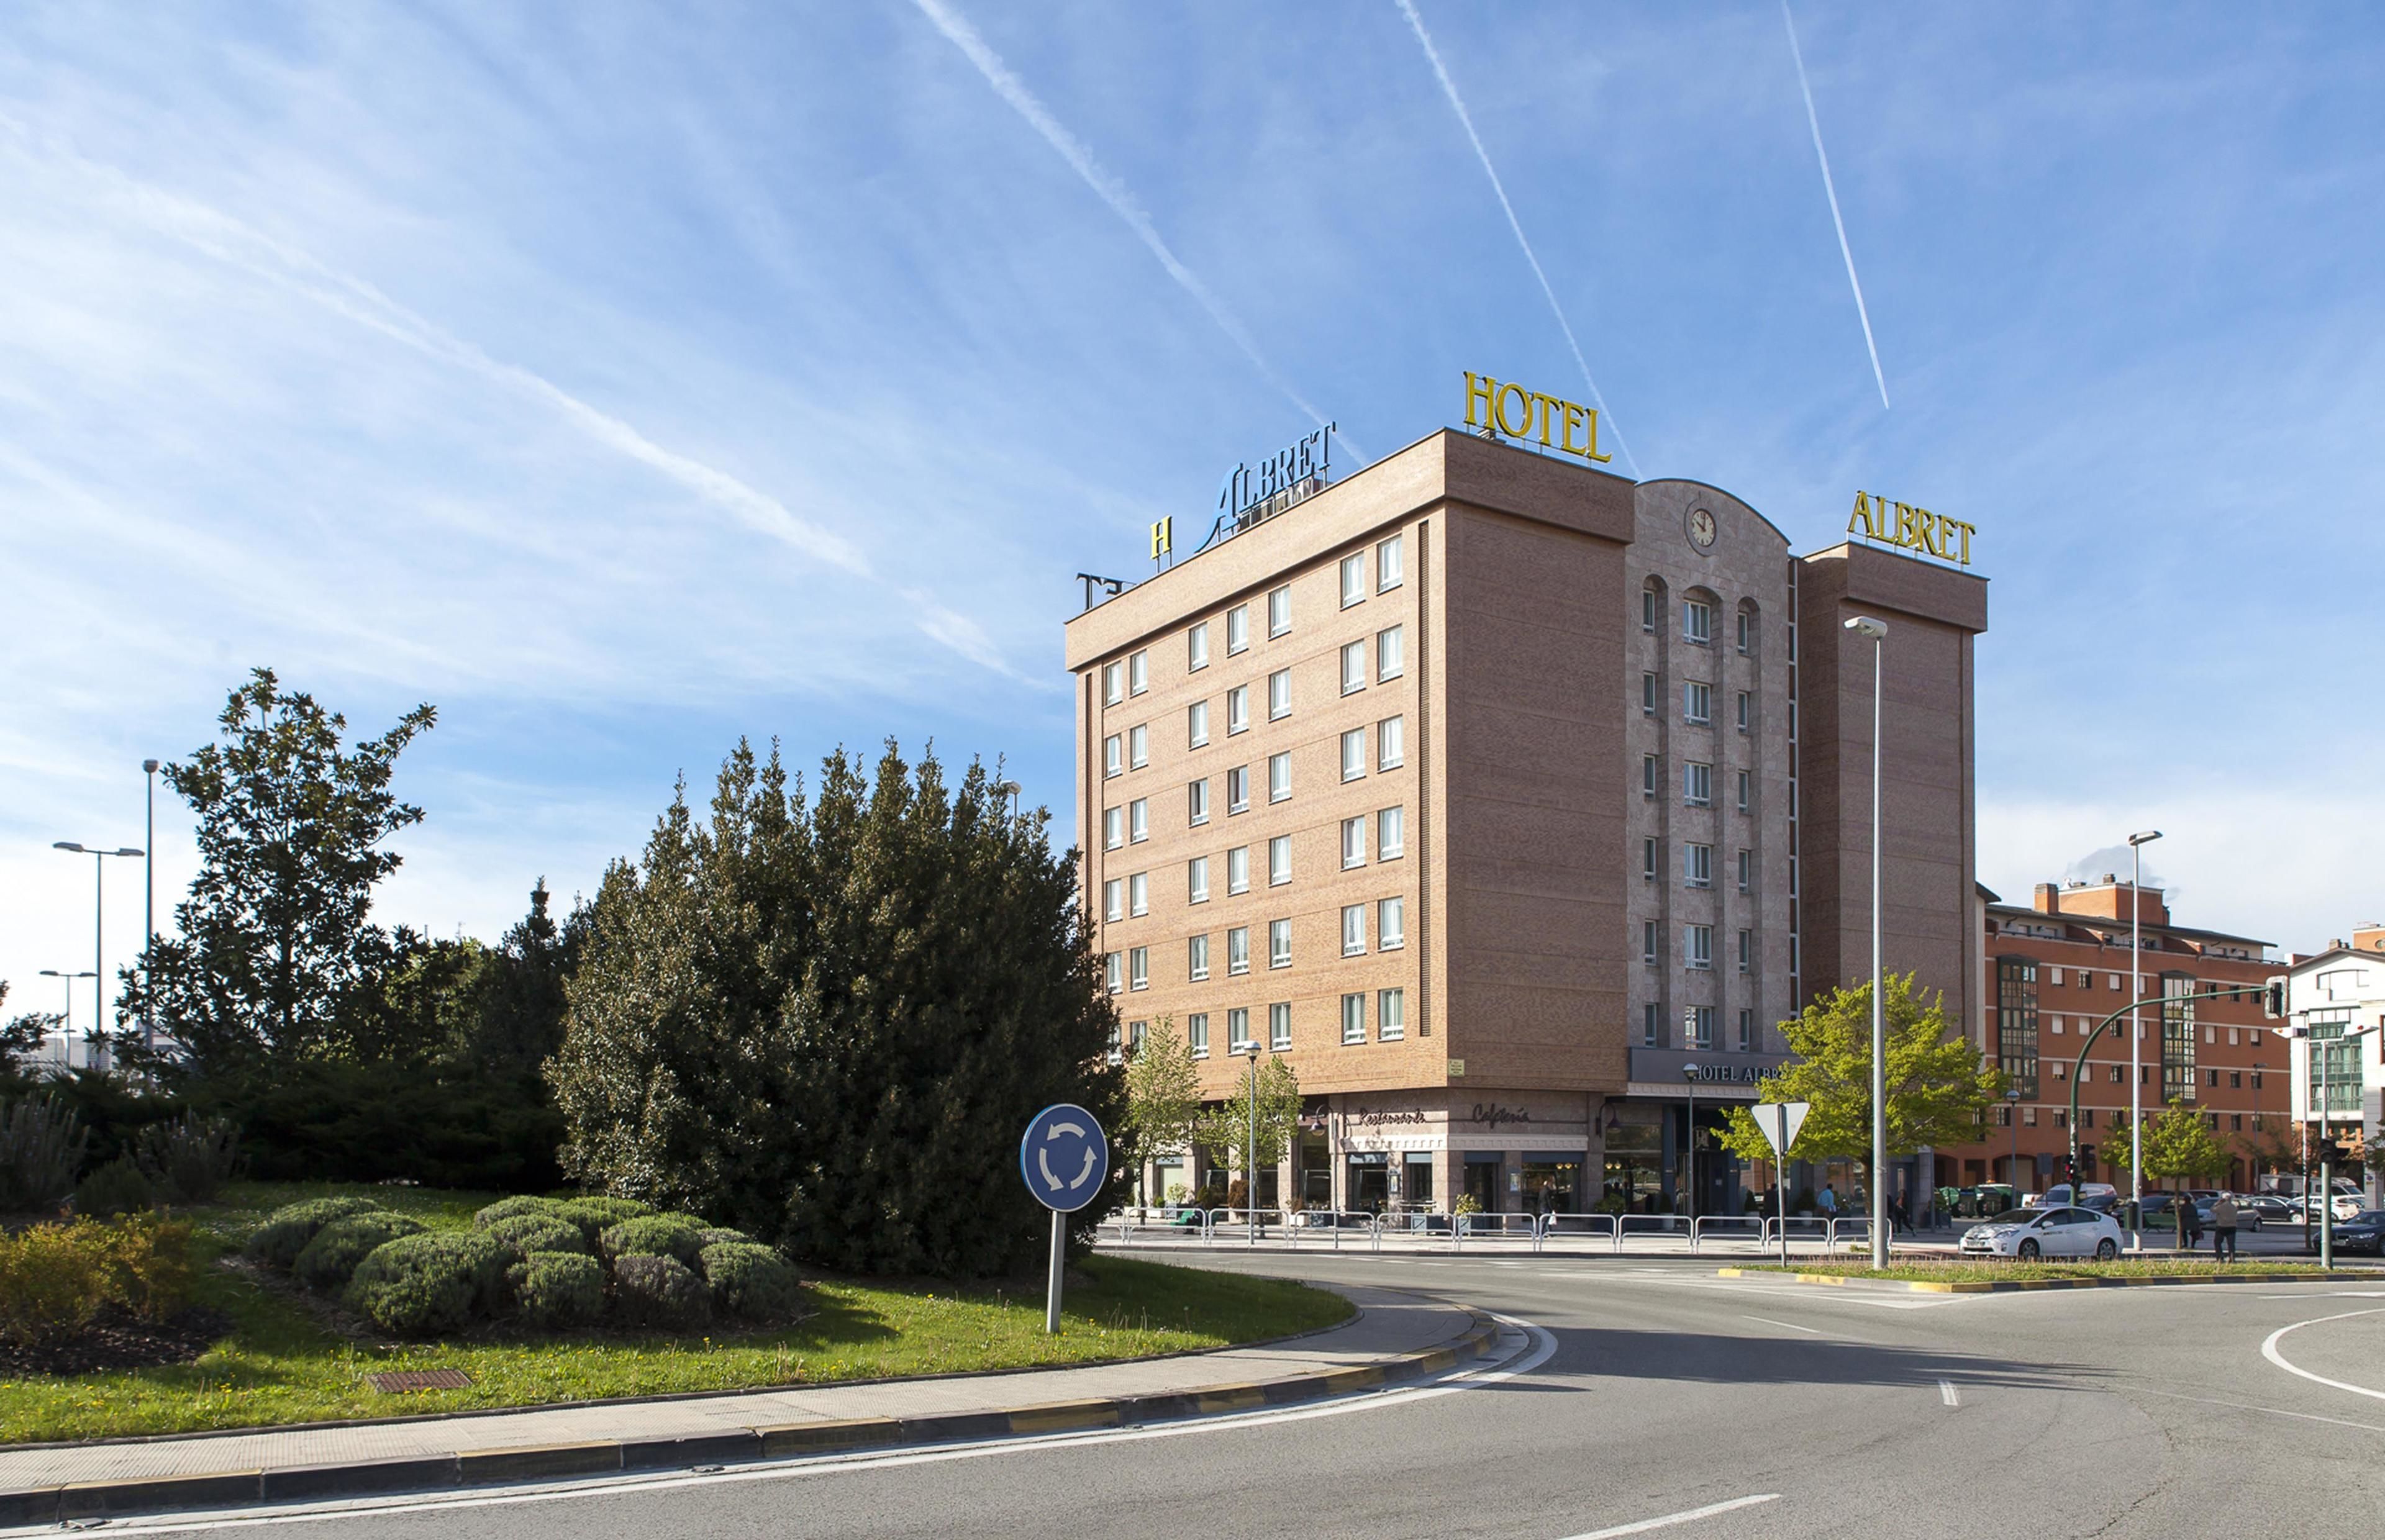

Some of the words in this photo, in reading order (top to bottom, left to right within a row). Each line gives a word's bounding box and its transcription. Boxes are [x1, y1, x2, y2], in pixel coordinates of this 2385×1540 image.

[1463, 371, 1612, 463] HOTEL
[1150, 515, 1173, 560] H
[1192, 420, 1337, 554] ALBRET
[1847, 490, 1976, 564] ALBRET
[1743, 1066, 1789, 1082] ALBR
[1473, 1103, 1530, 1129] Cafetería
